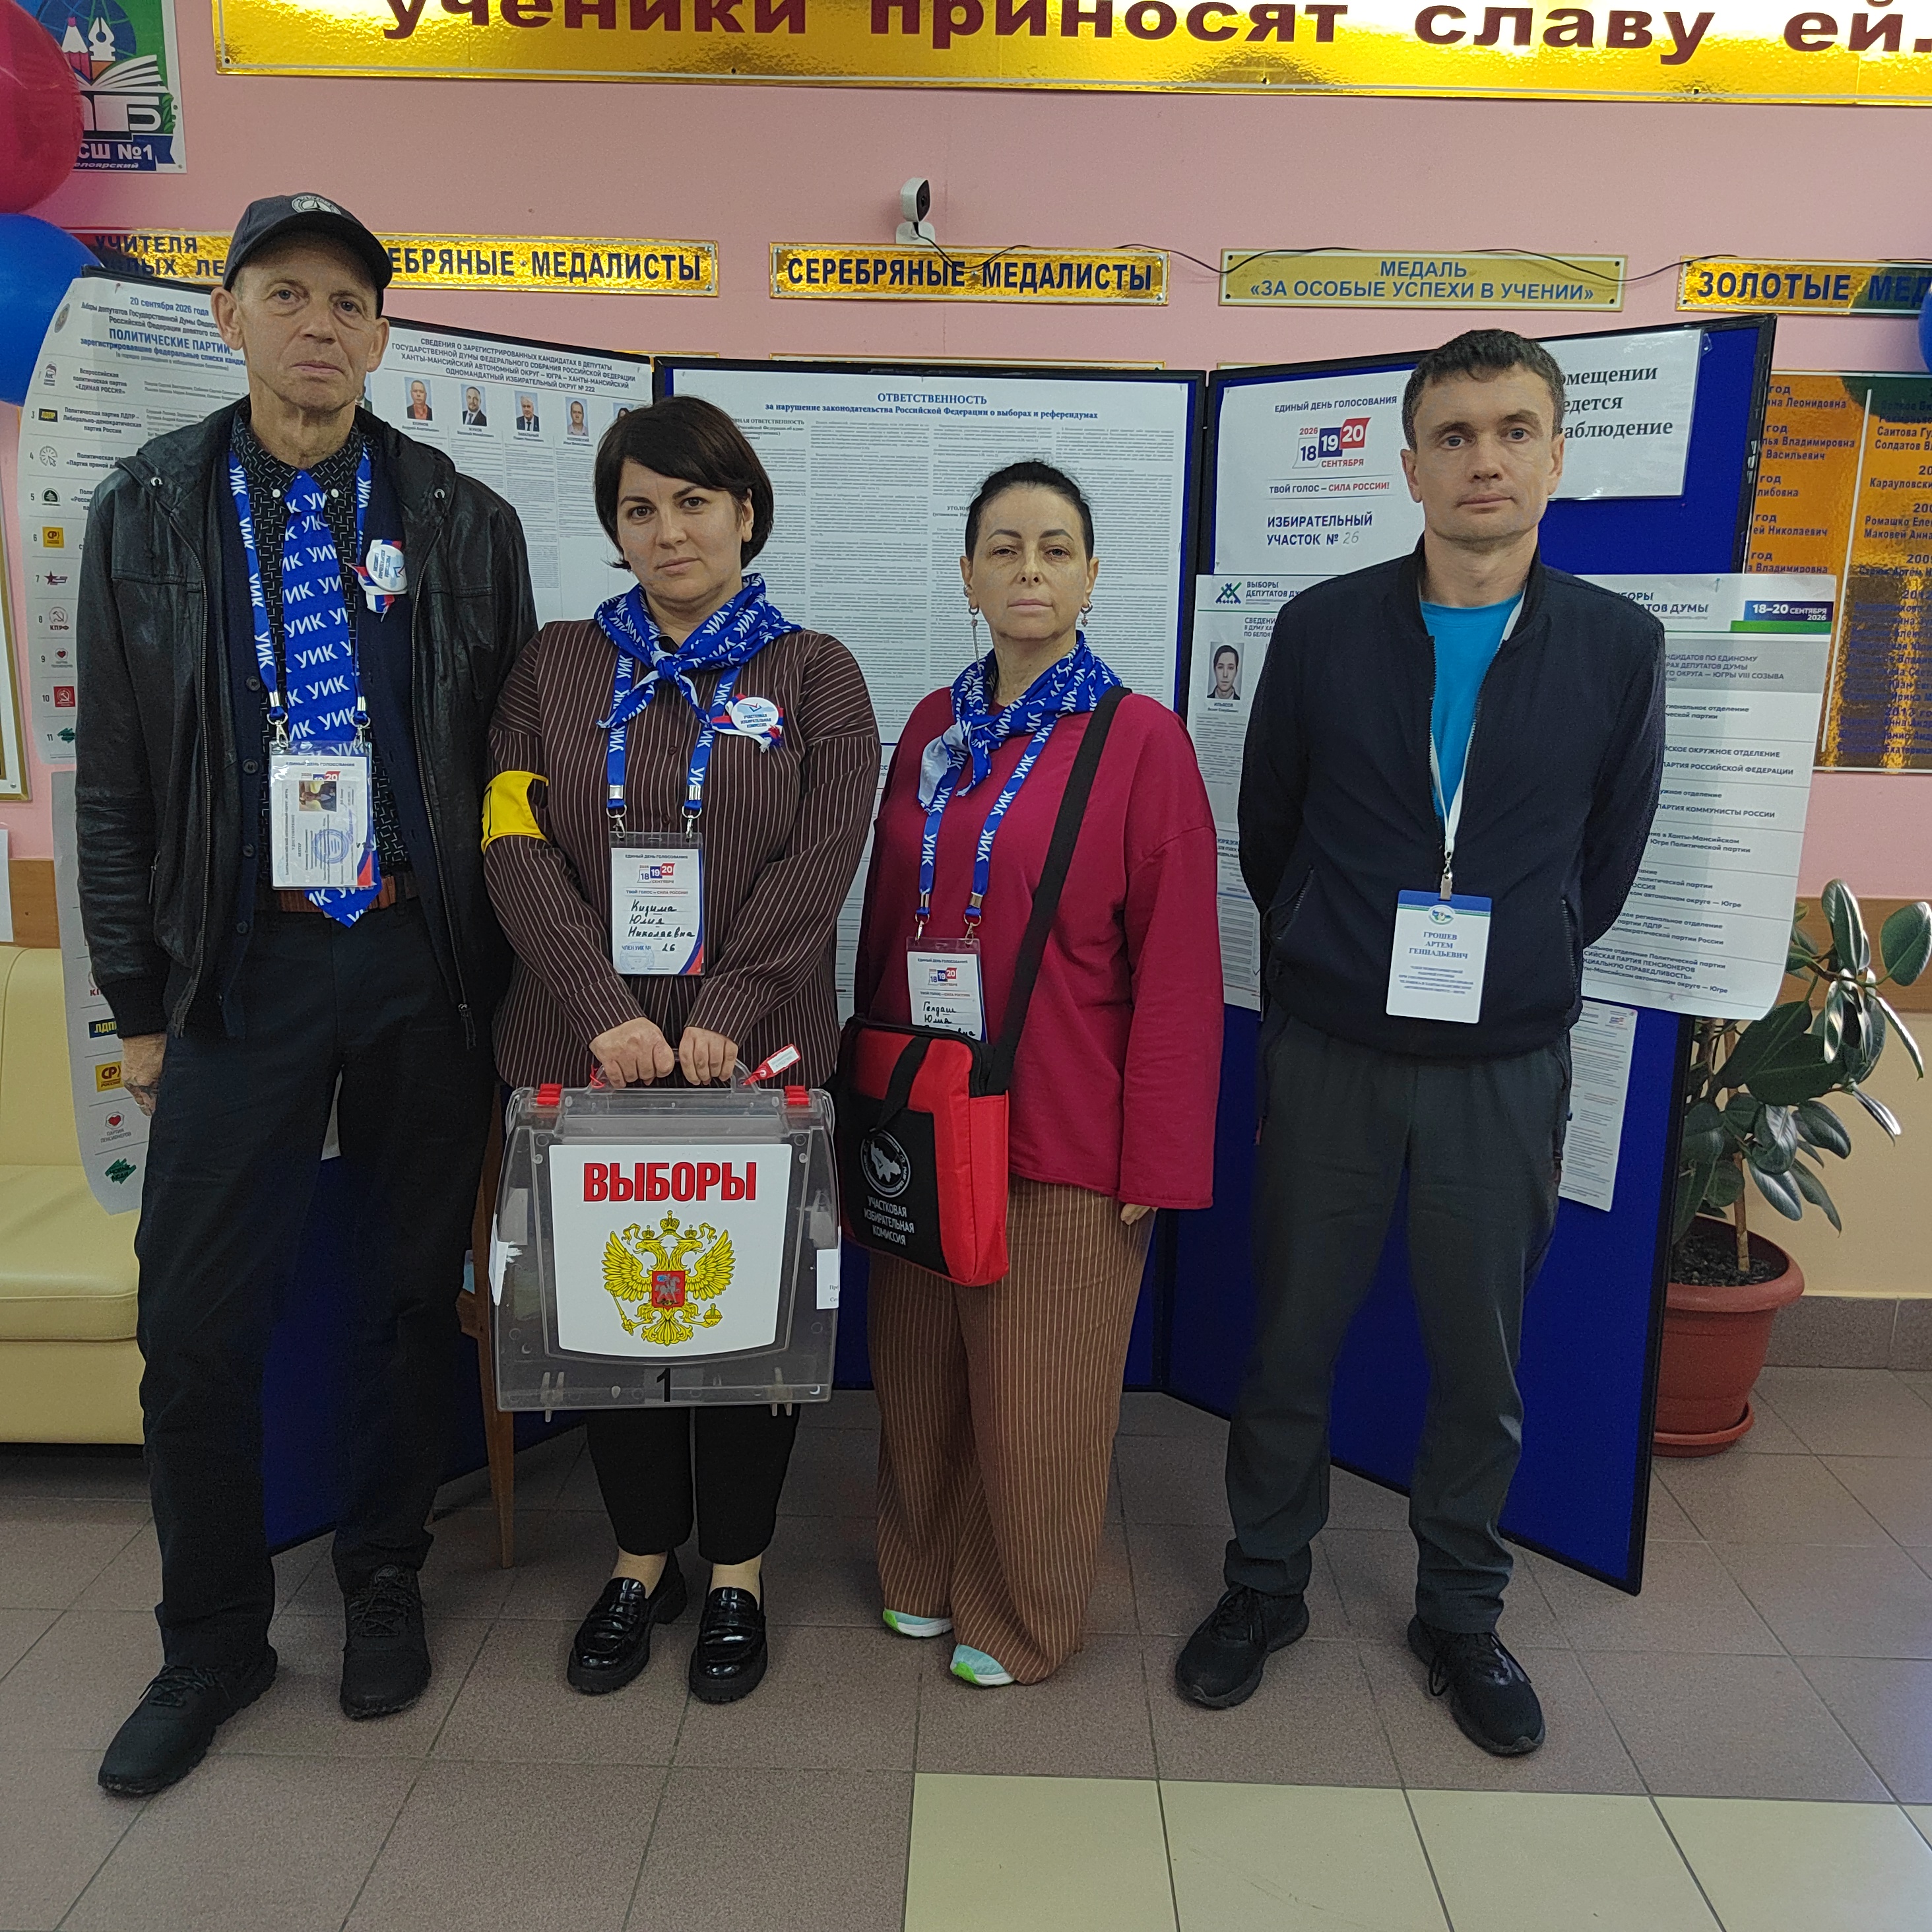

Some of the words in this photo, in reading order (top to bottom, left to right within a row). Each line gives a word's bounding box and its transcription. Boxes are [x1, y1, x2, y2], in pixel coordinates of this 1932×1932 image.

[383, 0, 806, 40] ученики
[870, 0, 1348, 49] приносят
[1414, 5, 1716, 65] славу
[96, 235, 197, 255] УЧИТЕЛЯ
[391, 247, 515, 276] ЕБРЯНЫЕ
[532, 251, 701, 284] МЕДАЛИСТЫ
[1380, 261, 1468, 278] МЕДАЛЬ
[788, 258, 966, 287] СЕРЕБРЯНЫЕ
[982, 261, 1152, 294] МЕДАЛИСТЫ
[1250, 280, 1287, 296] «ЗА
[1293, 280, 1388, 296] ОСОБЫЕ
[1392, 281, 1476, 298] УСПЕХИ
[1481, 282, 1495, 298] В
[1500, 283, 1594, 300] УЧЕНИИ»
[1696, 271, 1852, 301] ЗОЛОТЫЕ
[129, 296, 139, 306] 20
[141, 298, 174, 311] сентября
[175, 303, 192, 313] 2026
[193, 307, 209, 316] года
[109, 328, 190, 350] ПОЛИТИЧЕСКИЕ
[192, 340, 234, 356] ПАРТИИ,
[392, 342, 457, 357] ГОСУДАРСТВЕННОЙ
[480, 354, 532, 367] ФЕДЕРАЛЬНОГО
[530, 362, 562, 371] СОБРАНИЯ
[562, 366, 602, 377] РОССИЙСКОЙ
[602, 371, 636, 381] ФЕДЕРАЦИИ
[420, 338, 456, 348] СВЕДЕНИЯ
[463, 344, 536, 360] ЗАРЕГИСТРИРОВАННЫХ
[538, 355, 577, 366] КАНДИДАТАХ
[583, 361, 612, 370] ДЕПУТАТЫ
[401, 352, 473, 368] ХАНТЫ-МАНСИЙСКИЙ
[474, 363, 519, 374] АВТОНОМНЫЙ
[568, 375, 629, 389] ХАНТЫ-МАНСИЙСКИЙ
[445, 368, 505, 381] ОДНОМАНДАТНЫЙ
[505, 375, 558, 387] ИЗБИРАТЕЛЬНЫЙ
[1562, 366, 1658, 387] омещении
[877, 393, 988, 404] ОТВЕТСТВЕННОСТЬ
[1768, 385, 1791, 395] год
[775, 404, 821, 413] нарушение
[821, 404, 893, 414] законодательства
[895, 405, 942, 414] Российской
[943, 407, 988, 417] Федерации
[996, 408, 1032, 418] выборах
[1040, 409, 1099, 420] референдумах
[1274, 401, 1309, 412] ЕДИНЫЙ
[1310, 400, 1333, 410] ДЕНЬ
[1334, 396, 1398, 408] ГОЛОСОВАНИЯ
[1563, 396, 1623, 413] едется
[1785, 397, 1847, 409] Леонидовна
[1561, 420, 1673, 440] аблюдение
[1766, 424, 1788, 433] год
[1877, 426, 1917, 437] Саитова
[1300, 445, 1317, 461] 18
[1320, 434, 1339, 451] 19
[1341, 424, 1365, 442] 20
[1782, 436, 1855, 449] Владимировна
[1875, 439, 1921, 450] Солдатов
[1321, 458, 1365, 467] СЕНТЯБРЯ
[1766, 449, 1826, 460] Васильевич
[229, 465, 247, 496] УИК
[1269, 484, 1291, 494] ТВОЙ
[1292, 484, 1320, 493] ГОЛОС
[1353, 482, 1390, 490] РОССИИ!
[1759, 475, 1782, 484] год
[1267, 511, 1373, 527] ИЗБИРАТЕЛЬНЫЙ
[1755, 513, 1777, 523] год
[1865, 515, 1910, 526] Ромашко
[239, 517, 255, 550] УИК
[1266, 533, 1322, 546] УЧАСТОК
[1326, 533, 1339, 545] №
[1342, 531, 1360, 544] 26
[1768, 525, 1828, 536] Николаевич
[1863, 528, 1907, 538] Маковей
[1751, 552, 1773, 561] год
[1755, 563, 1828, 573] Владимировна
[249, 572, 265, 608] УИК
[1246, 589, 1288, 598] ДЕПУТАТОВ
[1670, 604, 1709, 613] ДУМЫ
[1753, 604, 1789, 614] 18–20
[284, 612, 327, 639] УИК
[702, 610, 729, 636] УИК
[254, 631, 274, 670] УИК
[294, 643, 338, 669] УИК
[616, 655, 633, 679] УИК
[306, 675, 350, 699] УИК
[712, 681, 733, 707] УИК
[609, 726, 626, 754] УИК
[1012, 754, 1037, 780] УИК
[1690, 763, 1744, 772] РОССИЙСКОЙ
[1745, 766, 1794, 775] ФЕДЕРАЦИИ
[932, 787, 953, 814] УИК
[990, 790, 1017, 816] УИК
[1685, 806, 1742, 816] КОММУНИСТЫ
[976, 829, 995, 862] УИК
[1667, 832, 1740, 844] Ханты-Мансийском
[922, 833, 937, 866] УИК
[661, 865, 673, 874] 20
[630, 899, 678, 917] Кизима
[629, 915, 665, 924] Юлия
[628, 926, 695, 938] Николаевна
[1423, 931, 1458, 940] ГРОШЕВ
[1408, 948, 1469, 959] ГЕННАДЬЕВИЧ
[1616, 955, 1642, 965] ПАРТИЯ
[1642, 959, 1696, 973] ПЕНСИОНЕРОВ
[1625, 964, 1692, 981] СПРАВЕДЛИВОСТЬ»
[583, 1162, 757, 1202] ВЫБОРЫ
[868, 1196, 907, 1218] УЧАСТКОВАЯ
[863, 1208, 915, 1234] ИЗБИРАТЕЛЬНАЯ
[872, 1225, 907, 1246] КОМИССИЯ
[656, 1367, 672, 1402] 1
